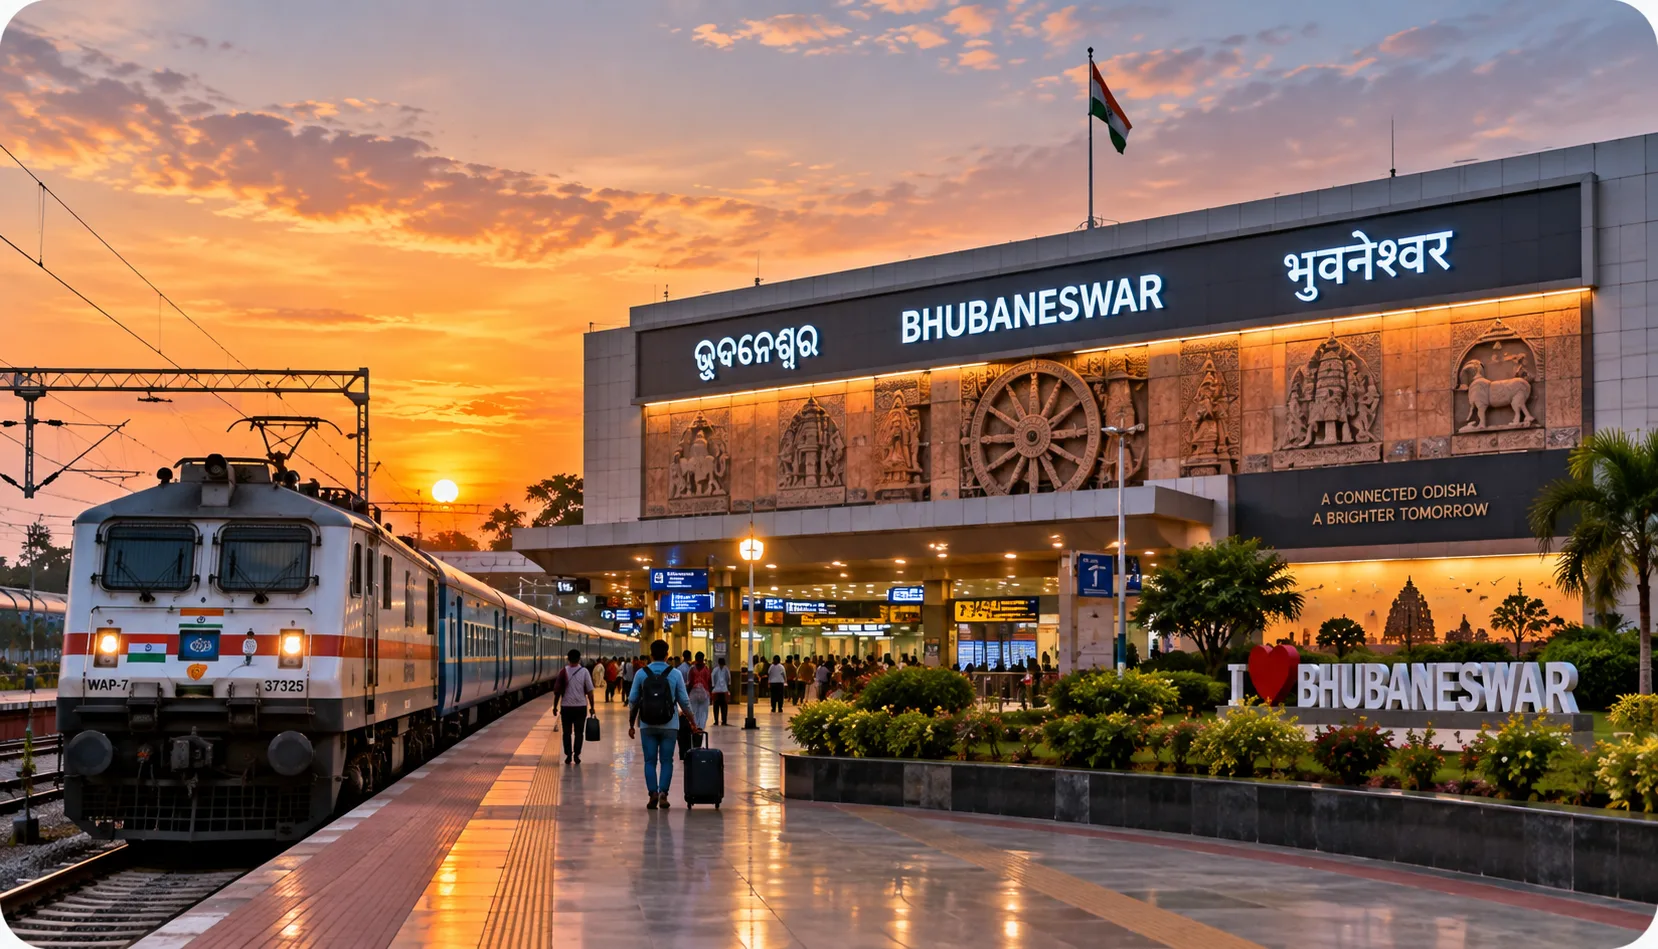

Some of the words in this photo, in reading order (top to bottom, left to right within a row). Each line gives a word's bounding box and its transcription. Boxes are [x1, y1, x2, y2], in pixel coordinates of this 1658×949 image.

[1284, 230, 1453, 302] भुवनेश्वर
[901, 274, 1164, 344] BHUBANESWAR
[1321, 493, 1331, 506] A
[1334, 487, 1417, 505] CONNECTED
[1422, 482, 1478, 499] ODISHA
[1312, 512, 1323, 526] A
[1326, 508, 1395, 525] BRIGHTER
[1400, 502, 1489, 520] TOMORROW
[87, 678, 129, 692] WAP-7
[264, 679, 305, 693] 37325
[1227, 663, 1248, 706] I
[1297, 661, 1579, 714] BHUBANESWAR
